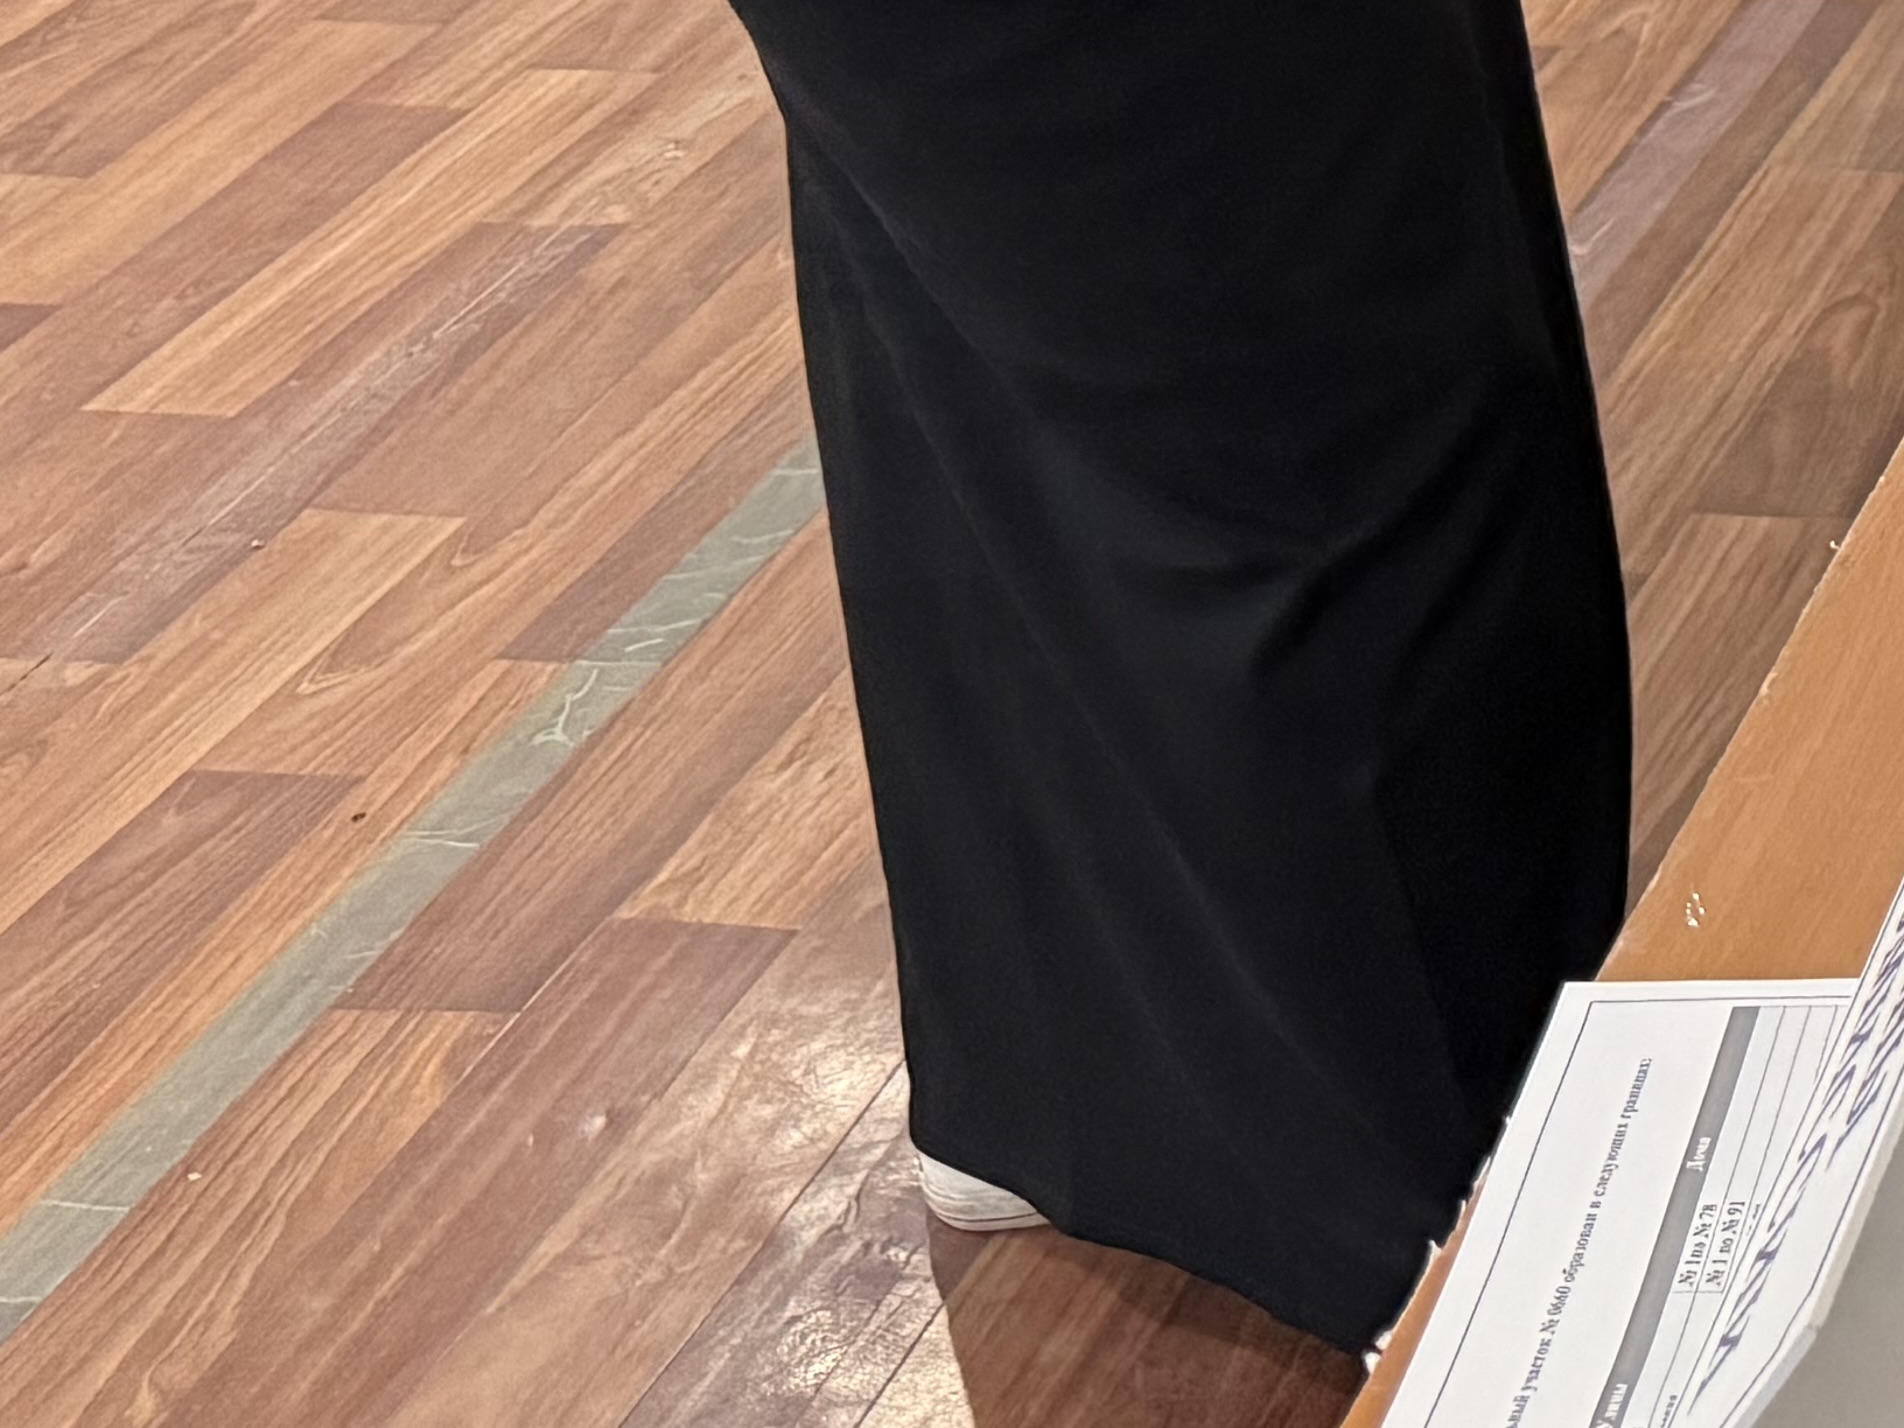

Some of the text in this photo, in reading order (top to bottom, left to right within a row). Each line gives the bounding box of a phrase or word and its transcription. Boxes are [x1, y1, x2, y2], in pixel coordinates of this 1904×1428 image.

[1702, 1204, 1718, 1220] 78
[1731, 1201, 1746, 1217] 91
[1547, 1287, 1571, 1316] 0660
[1563, 1219, 1595, 1283] образован
[1594, 1121, 1629, 1197] следующих
